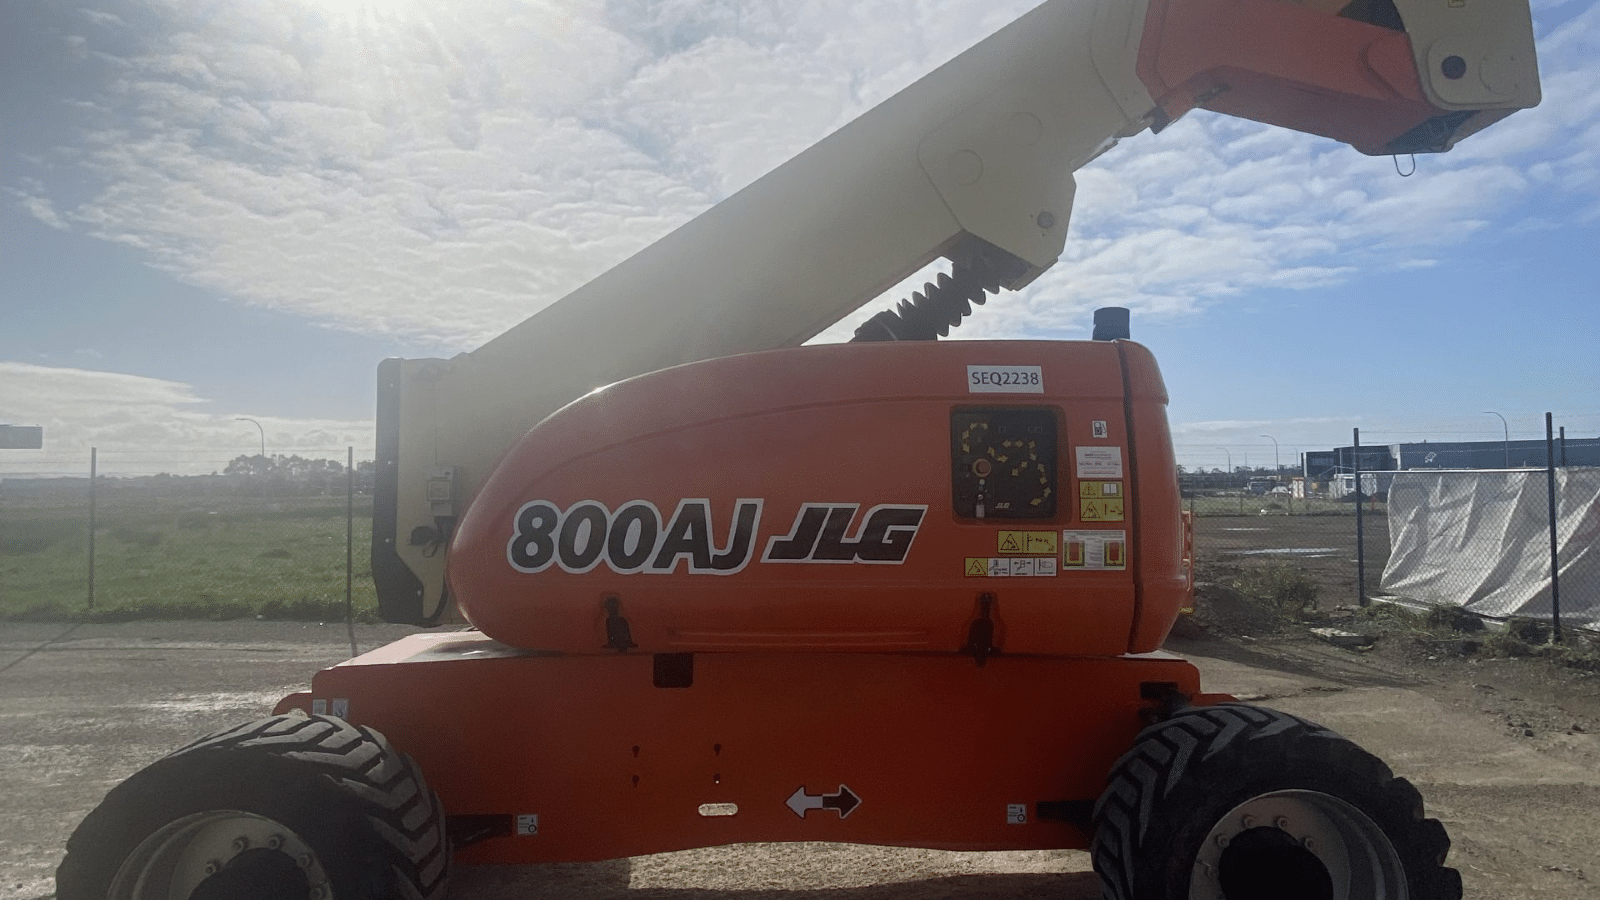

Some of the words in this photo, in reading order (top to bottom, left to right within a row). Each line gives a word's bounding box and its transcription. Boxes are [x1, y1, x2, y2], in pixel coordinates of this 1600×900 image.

[972, 372, 1039, 386] SEQ2238
[508, 499, 763, 574] 800AJ
[761, 503, 928, 564] JLG
